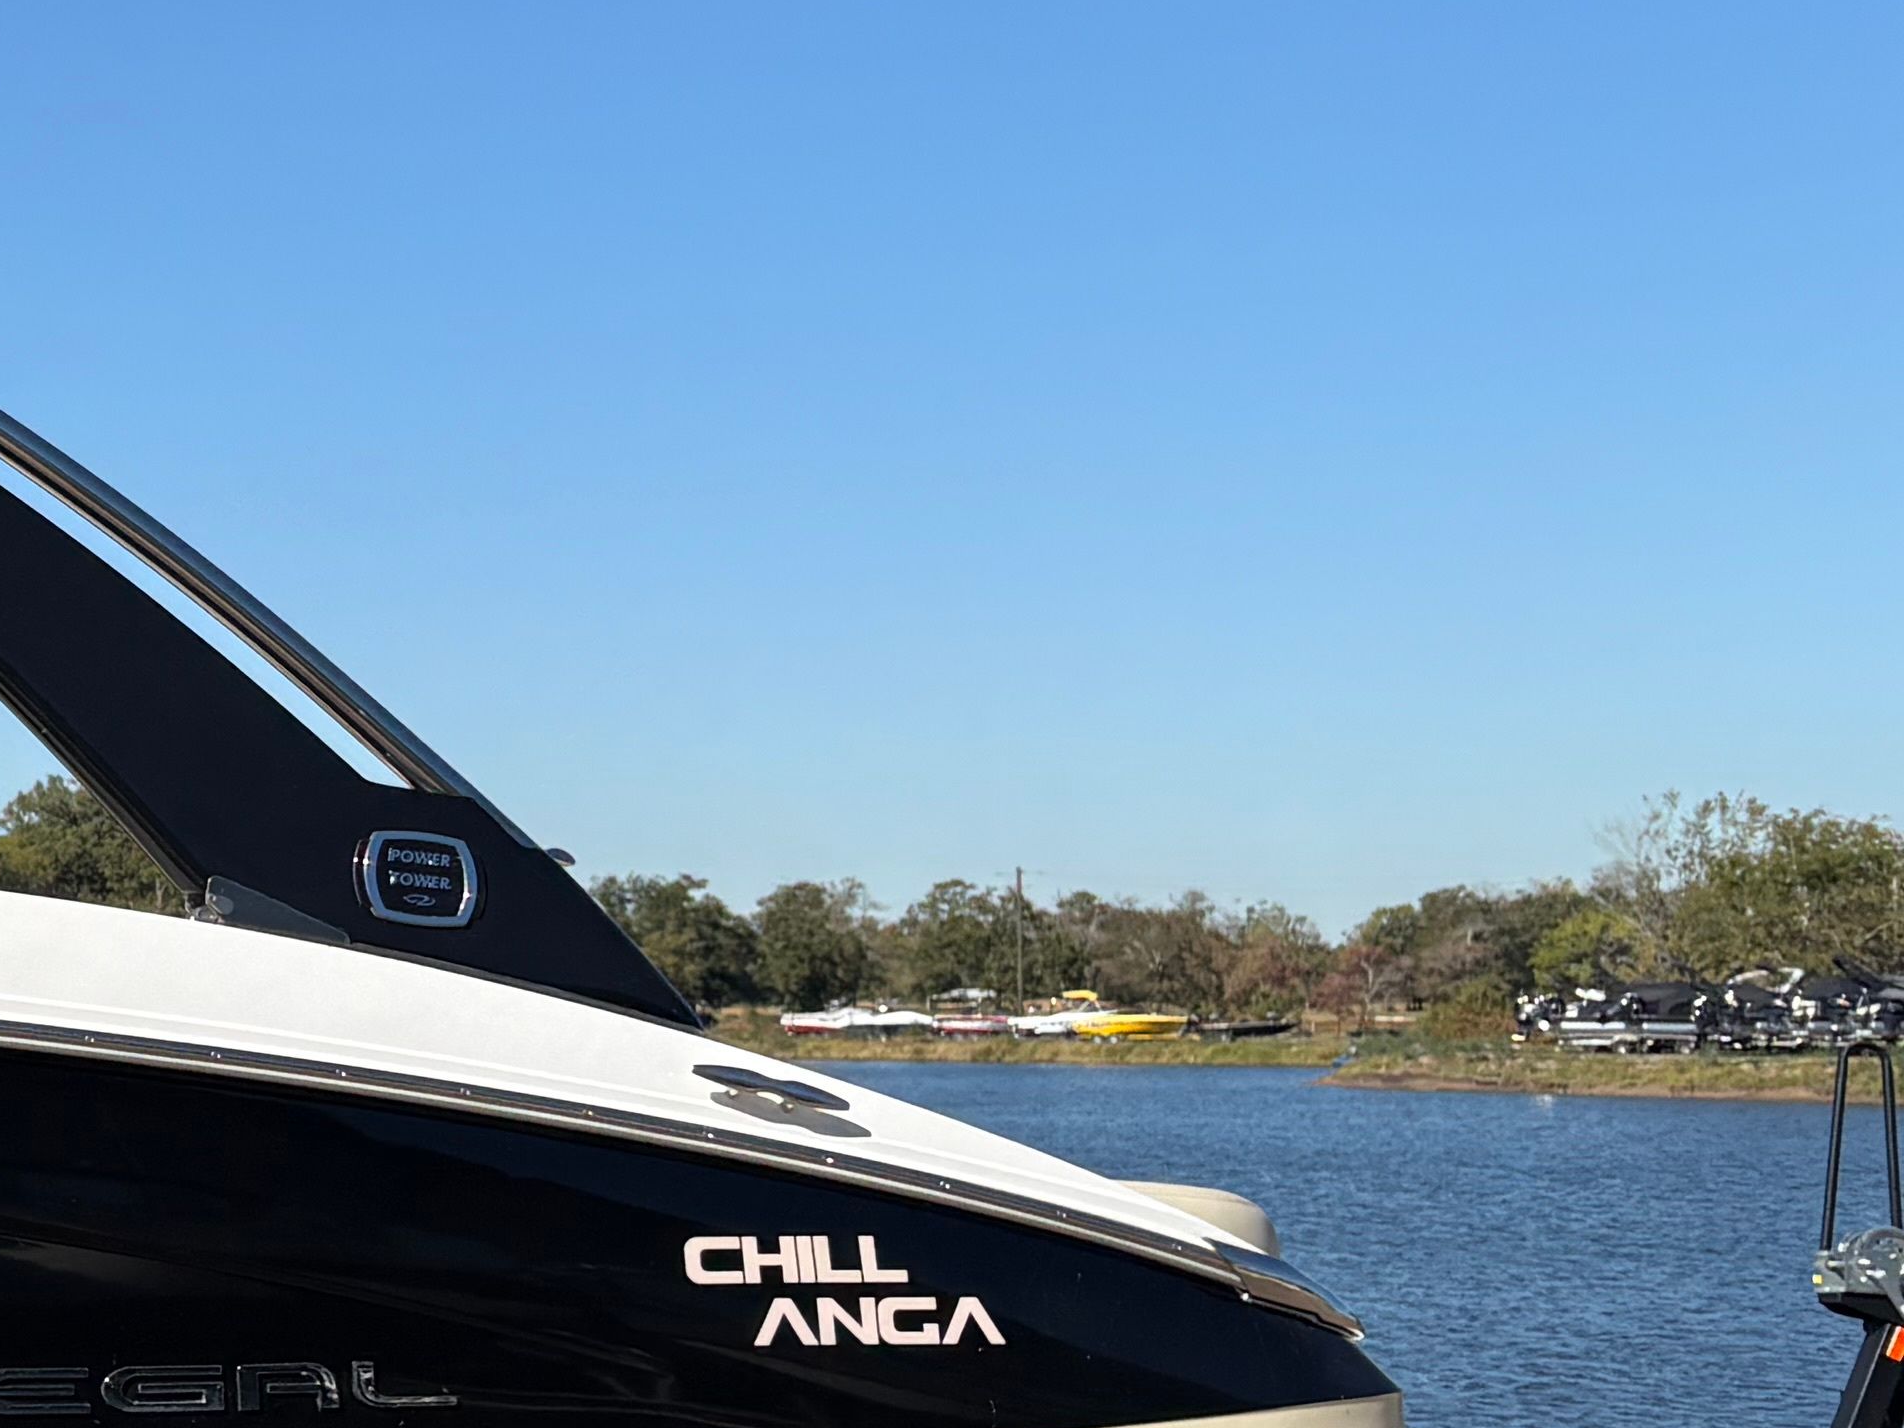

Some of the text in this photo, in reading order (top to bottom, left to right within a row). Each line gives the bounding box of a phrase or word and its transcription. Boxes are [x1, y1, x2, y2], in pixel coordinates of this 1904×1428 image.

[387, 847, 451, 867] POWER
[388, 869, 452, 890] TOWER
[683, 1235, 909, 1285] CHILL
[753, 1296, 1006, 1347] ANGA
